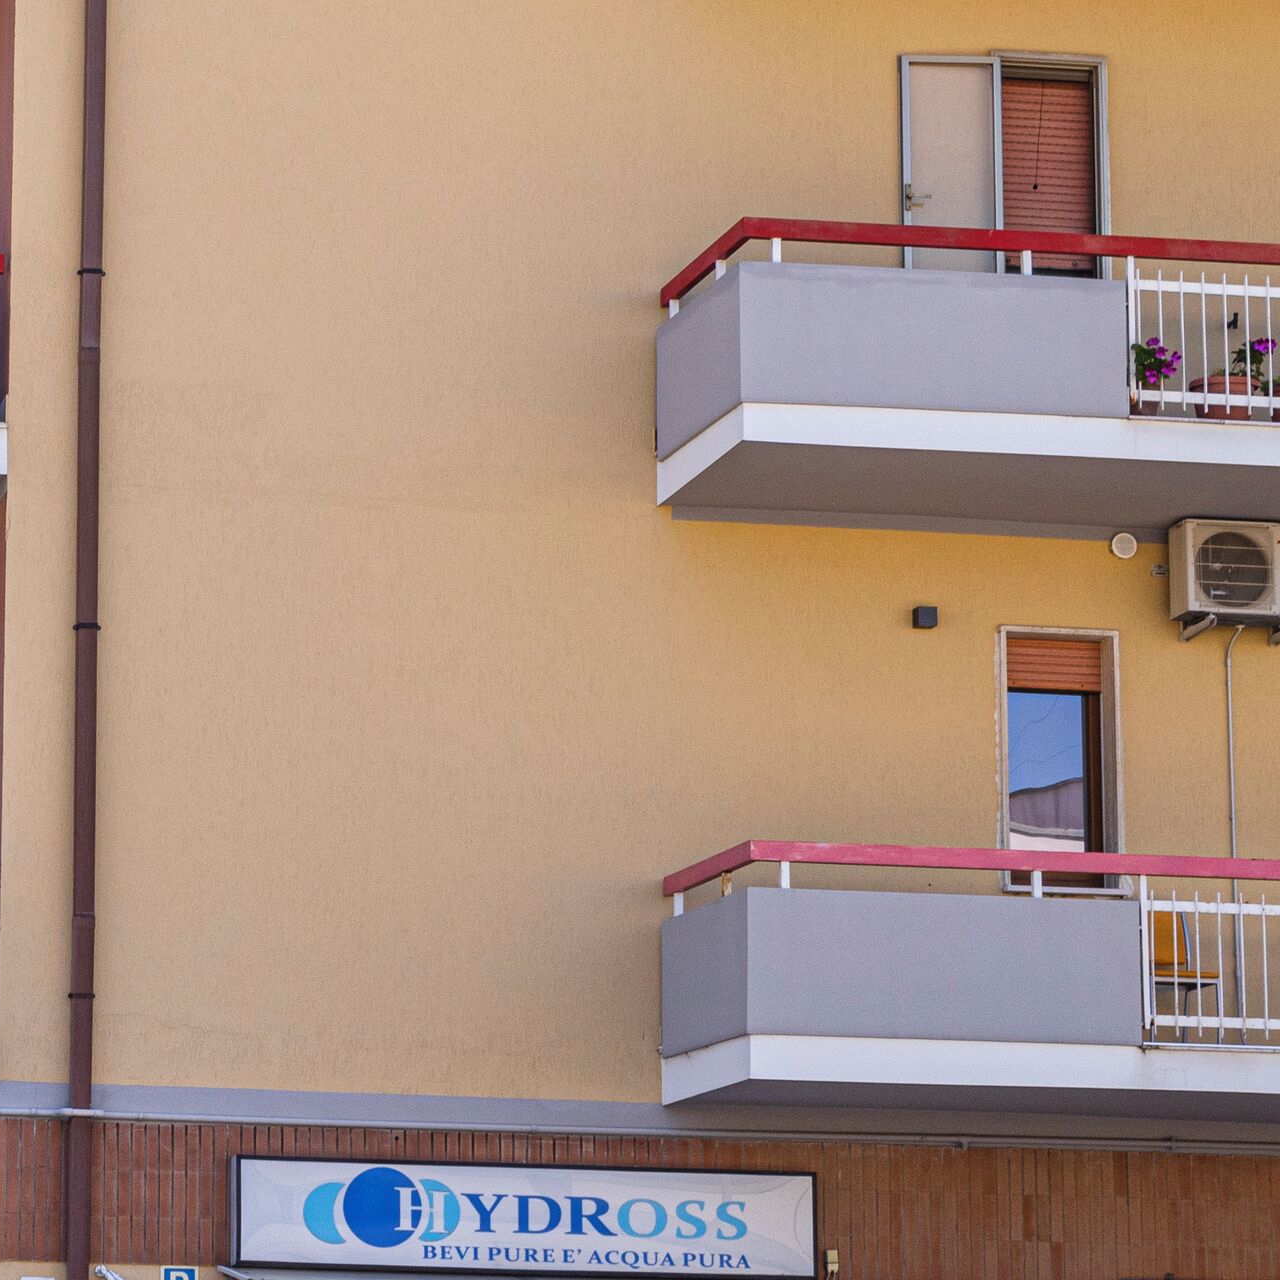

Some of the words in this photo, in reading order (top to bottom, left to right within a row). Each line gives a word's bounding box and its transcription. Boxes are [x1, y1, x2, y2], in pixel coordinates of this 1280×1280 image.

[394, 1186, 750, 1241] HYDROSS
[423, 1245, 480, 1261] BEVI
[488, 1246, 555, 1264] PURE
[588, 1249, 675, 1269] ACQUA
[682, 1252, 751, 1269] PURA
